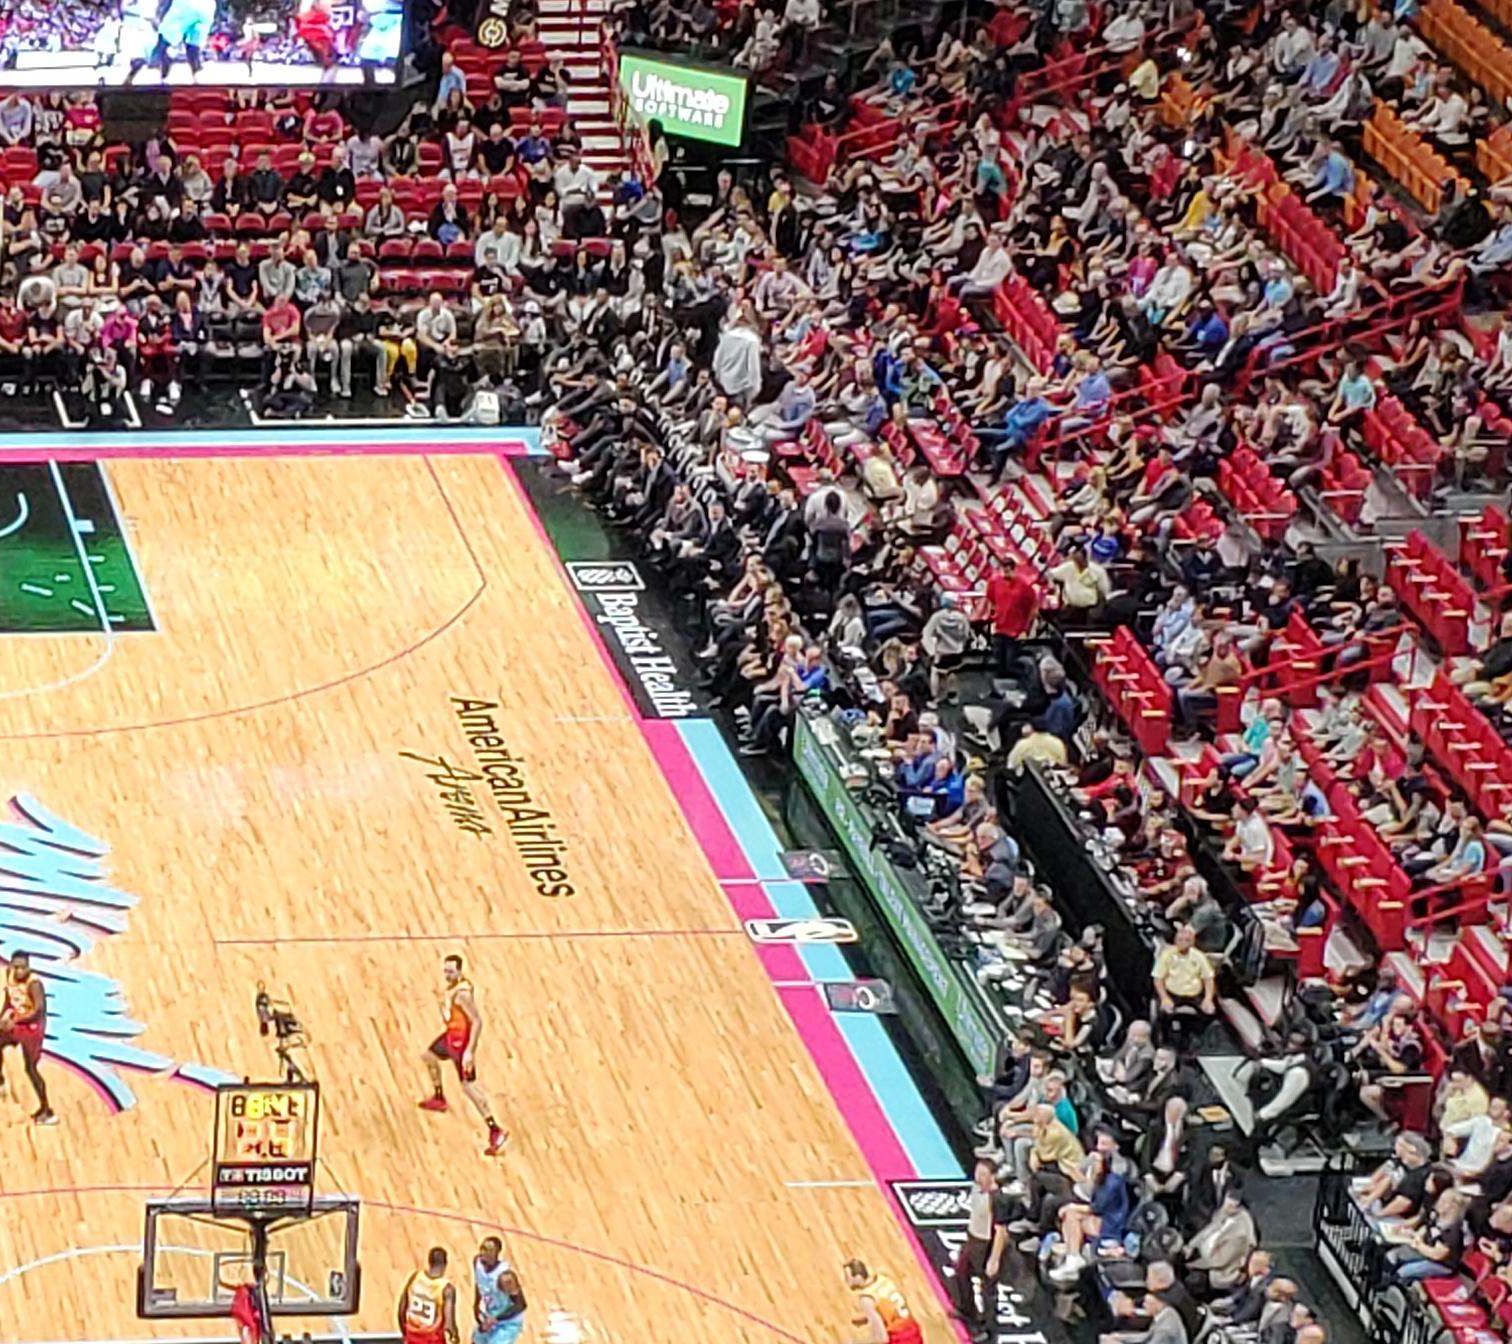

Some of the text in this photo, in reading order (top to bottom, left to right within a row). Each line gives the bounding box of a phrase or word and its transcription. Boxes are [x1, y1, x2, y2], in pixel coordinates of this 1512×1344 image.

[632, 70, 730, 114] Ultimate
[634, 97, 724, 129] SOFTWARE
[596, 592, 698, 717] Baptist Health
[245, 1167, 308, 1183] TISSOT
